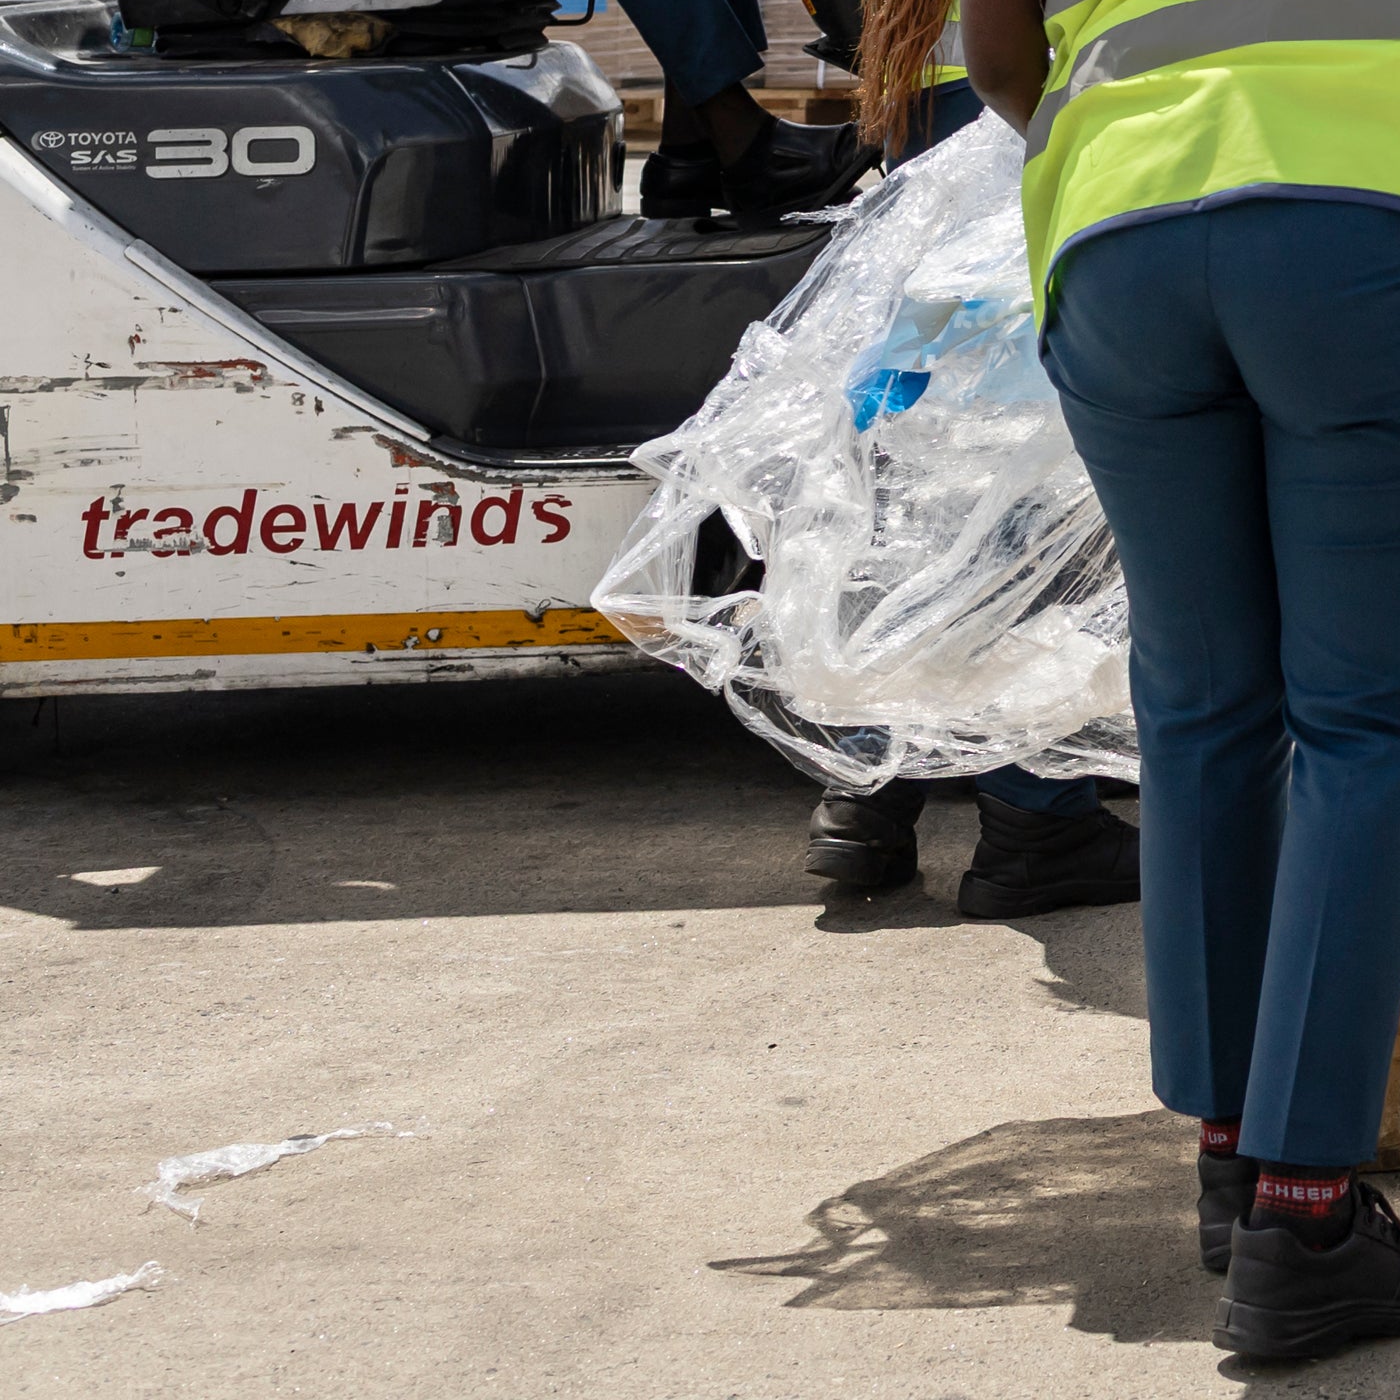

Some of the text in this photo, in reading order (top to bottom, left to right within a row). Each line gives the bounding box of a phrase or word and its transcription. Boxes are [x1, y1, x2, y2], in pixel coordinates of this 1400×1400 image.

[68, 131, 137, 146] TOYOTA
[70, 149, 138, 165] SAS
[145, 125, 316, 179] 30
[81, 484, 573, 561] tradewinds
[1208, 1131, 1228, 1144] UP
[1262, 1181, 1333, 1201] CHEER
